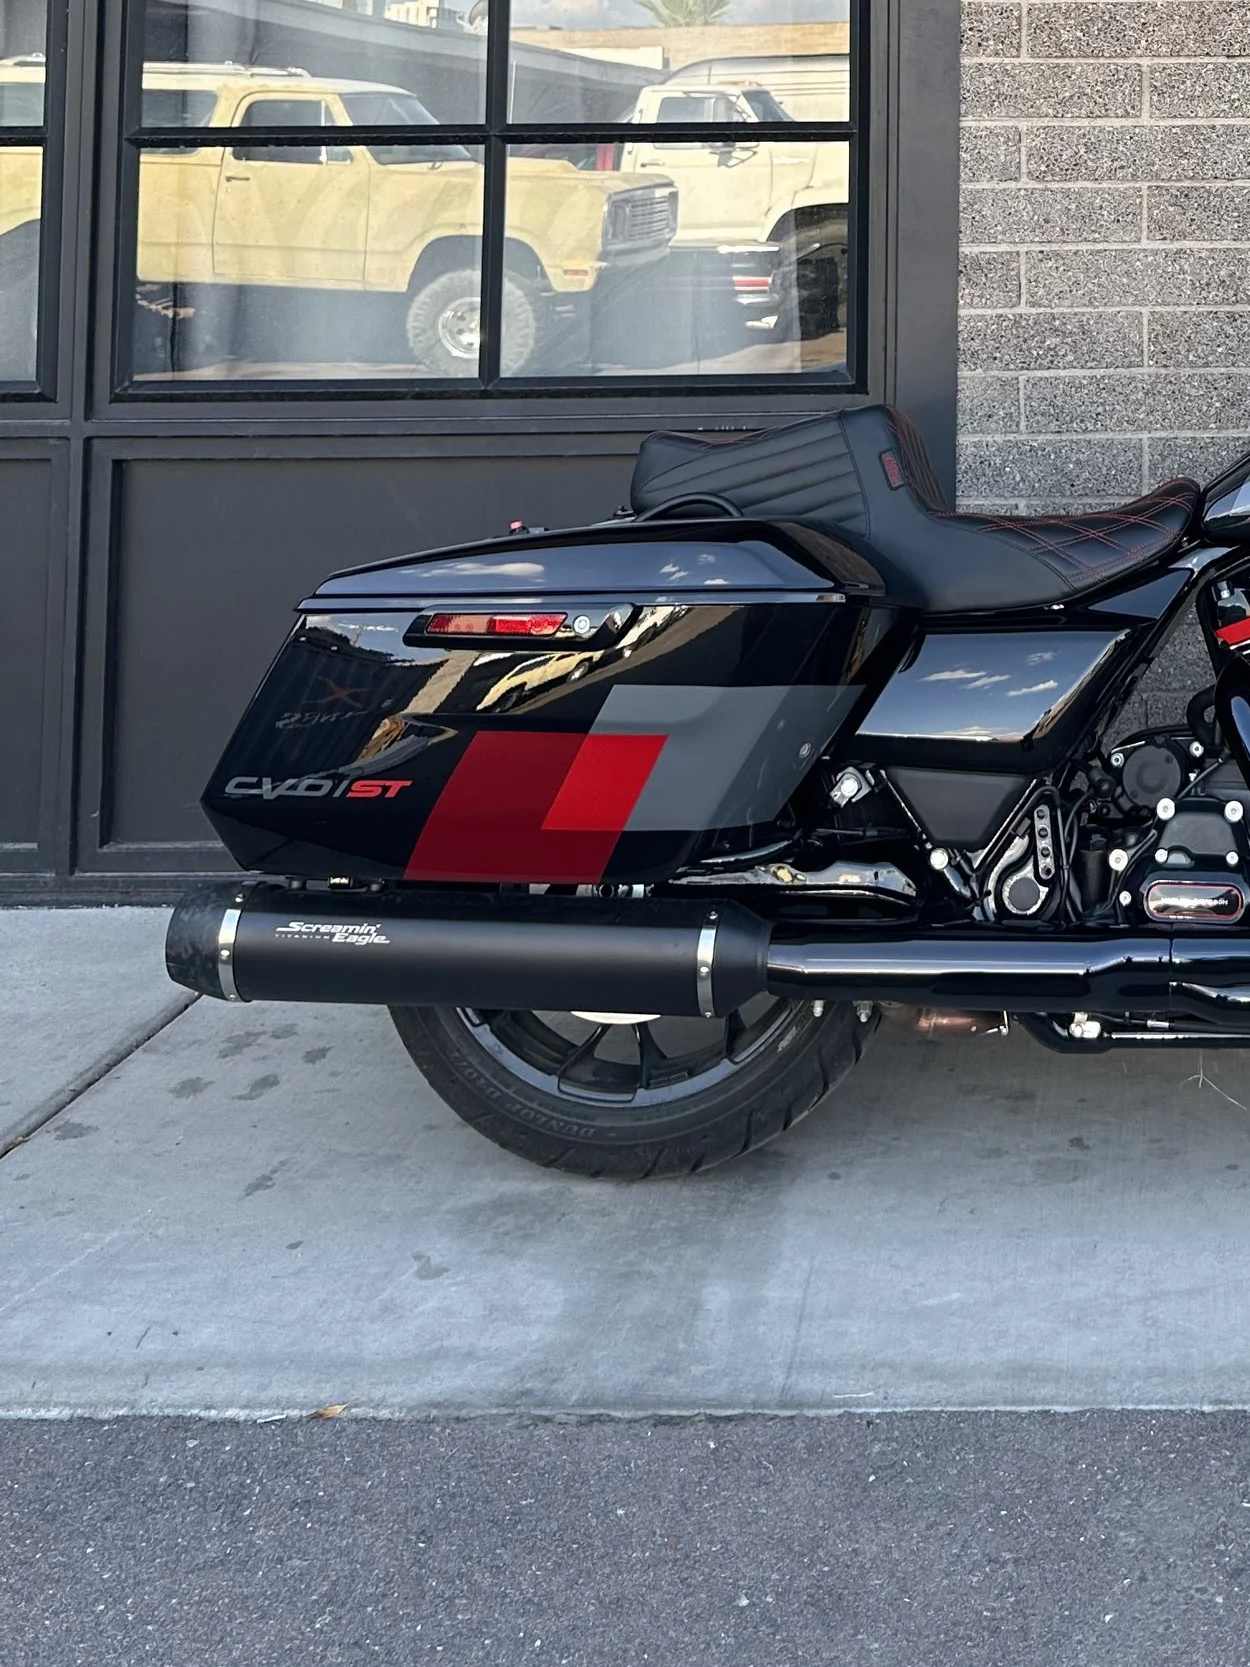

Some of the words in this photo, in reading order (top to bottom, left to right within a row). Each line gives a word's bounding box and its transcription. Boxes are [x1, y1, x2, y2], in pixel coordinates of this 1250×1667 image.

[275, 921, 381, 934] Screamin'
[331, 932, 391, 945] Eagle
[505, 1102, 597, 1138] DUNLOP
